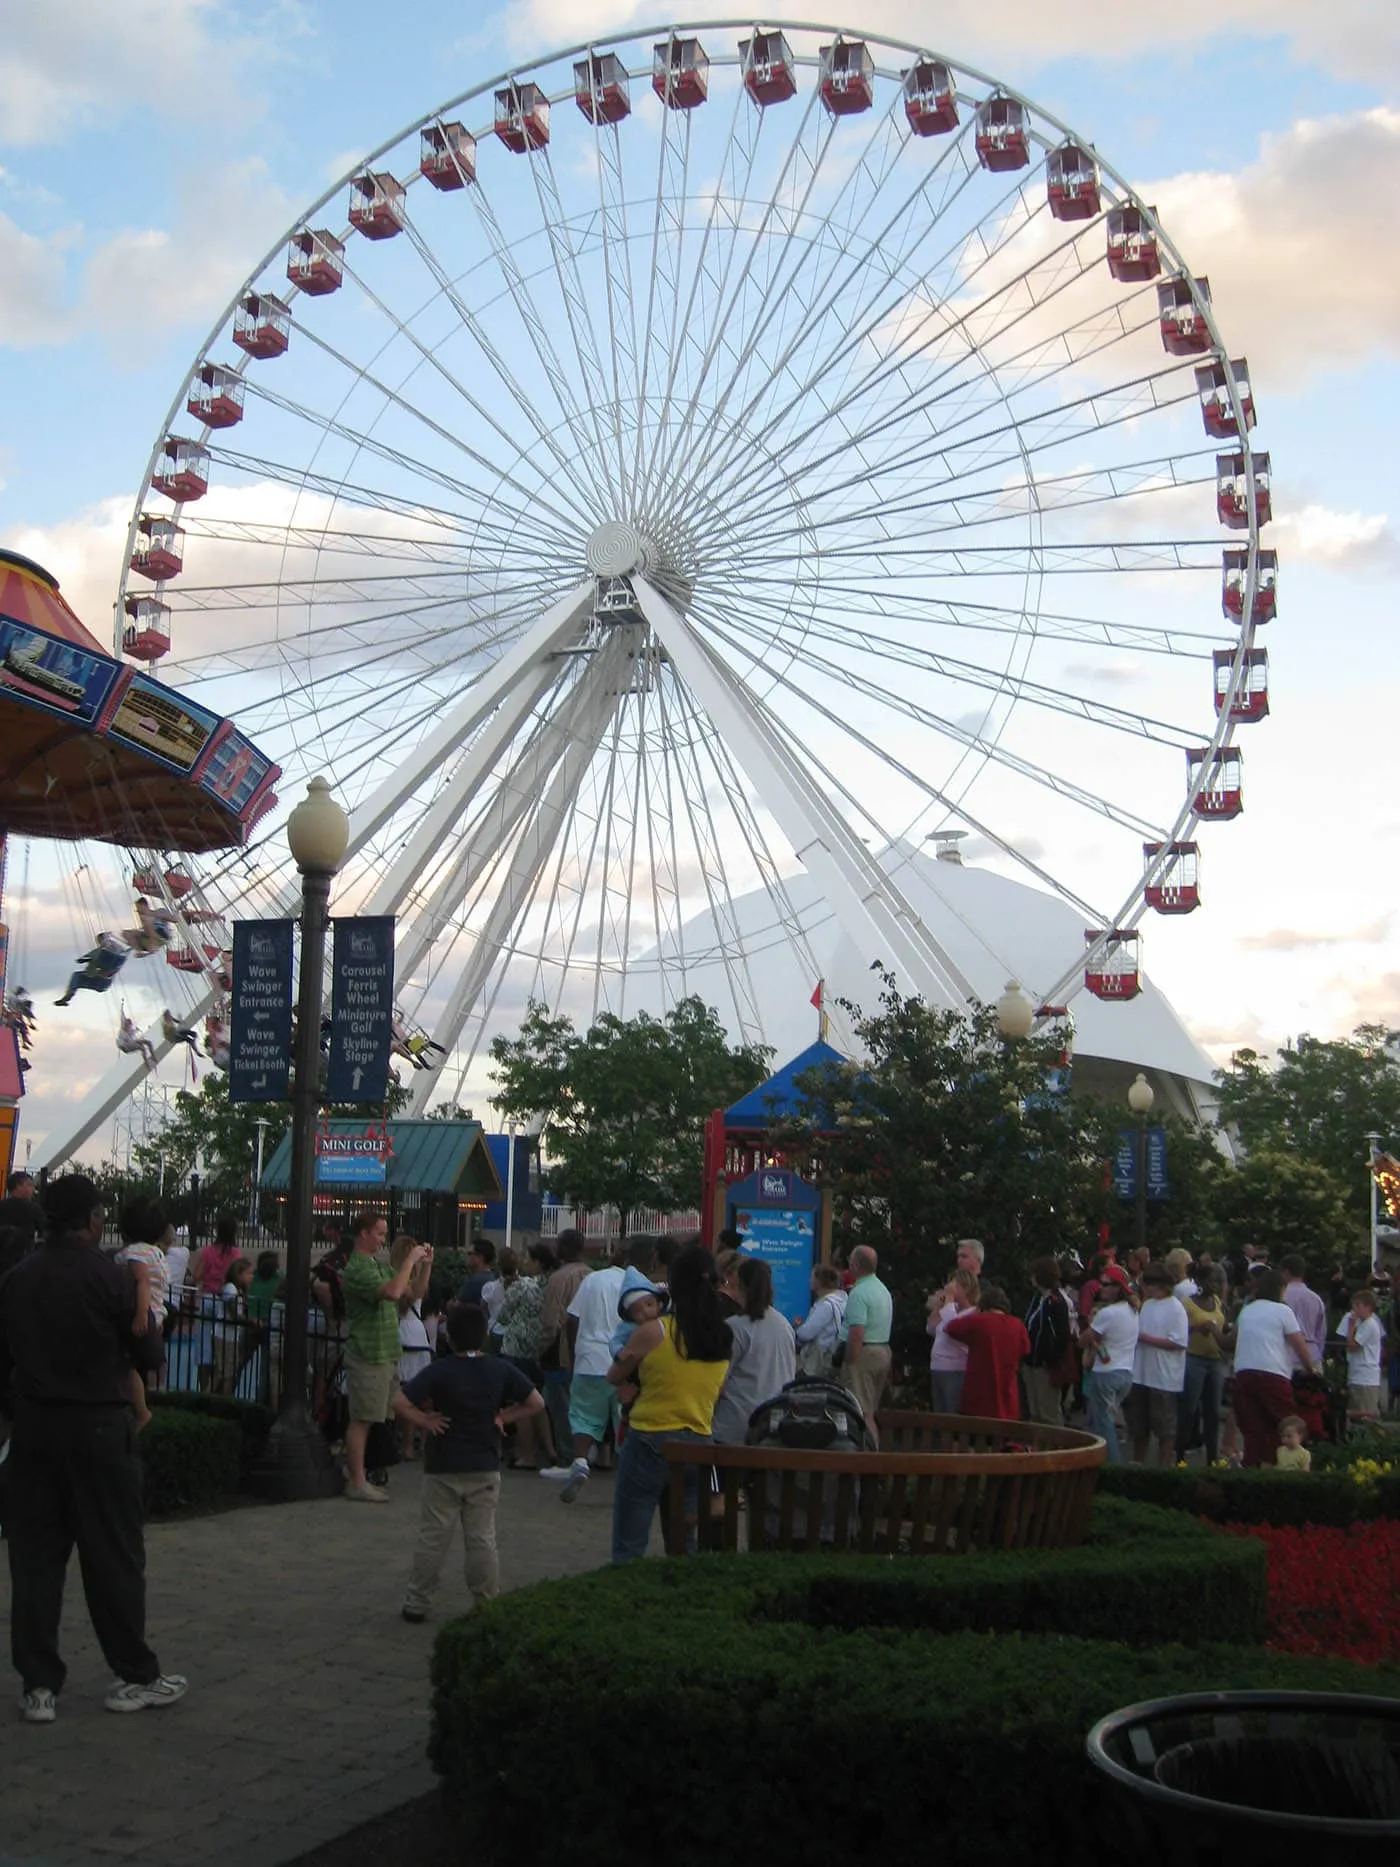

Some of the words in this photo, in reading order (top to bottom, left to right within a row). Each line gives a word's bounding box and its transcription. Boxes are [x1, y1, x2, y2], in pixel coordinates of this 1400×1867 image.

[248, 965, 277, 977] Wave
[341, 964, 386, 977] Carousel
[241, 981, 282, 993] Swinger
[348, 979, 378, 991] Ferris
[239, 996, 285, 1008] Entrance
[346, 992, 380, 1005] Wheel
[338, 1009, 387, 1021] Miniature
[351, 1021, 373, 1033] Golf
[247, 1028, 275, 1040] Wave
[240, 1043, 281, 1056] Swinger
[343, 1037, 379, 1053] Skyline
[345, 1050, 374, 1065] Stage
[234, 1059, 259, 1071] Ticket
[259, 1059, 286, 1070] Booth
[322, 1139, 351, 1151] MINI
[353, 1139, 386, 1152] GOLF
